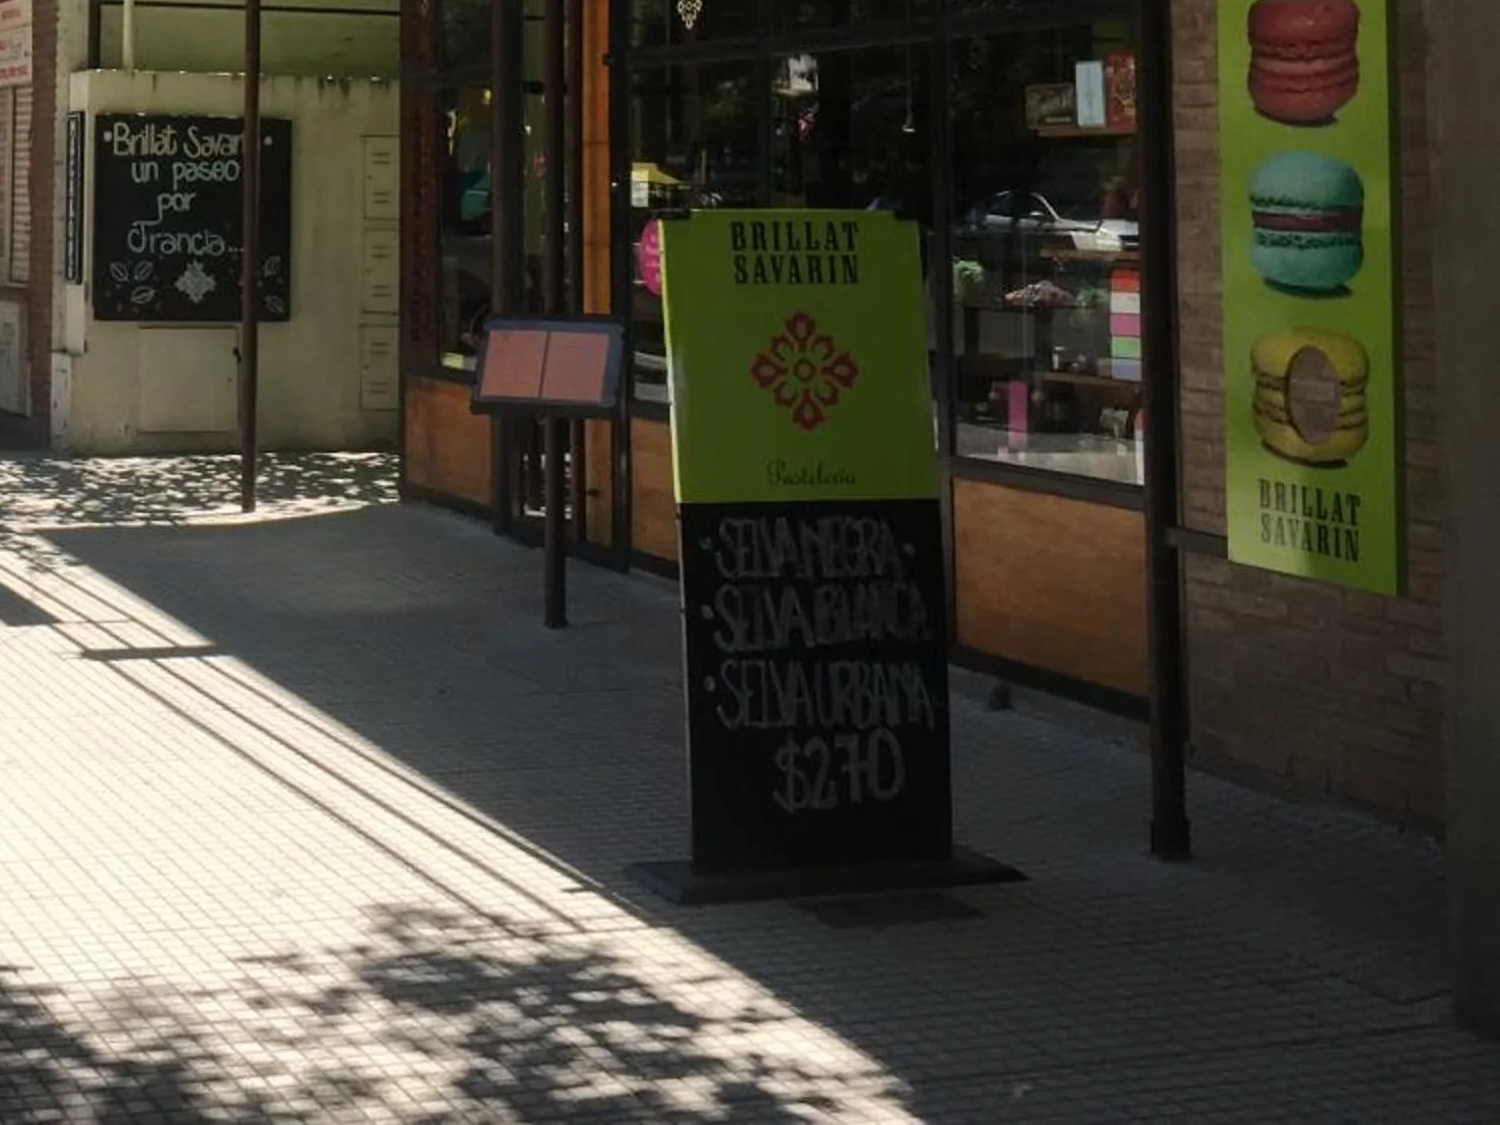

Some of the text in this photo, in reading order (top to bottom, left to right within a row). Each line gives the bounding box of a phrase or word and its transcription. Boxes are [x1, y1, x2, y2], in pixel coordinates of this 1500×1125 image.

[131, 158, 240, 191] un paseo
[156, 191, 196, 223] por
[730, 220, 859, 253] BRILLAT
[733, 253, 859, 286] SAVARIN
[1258, 478, 1361, 526] BRILLAT
[1260, 512, 1360, 563] SAVARIN
[771, 727, 907, 815] $270
